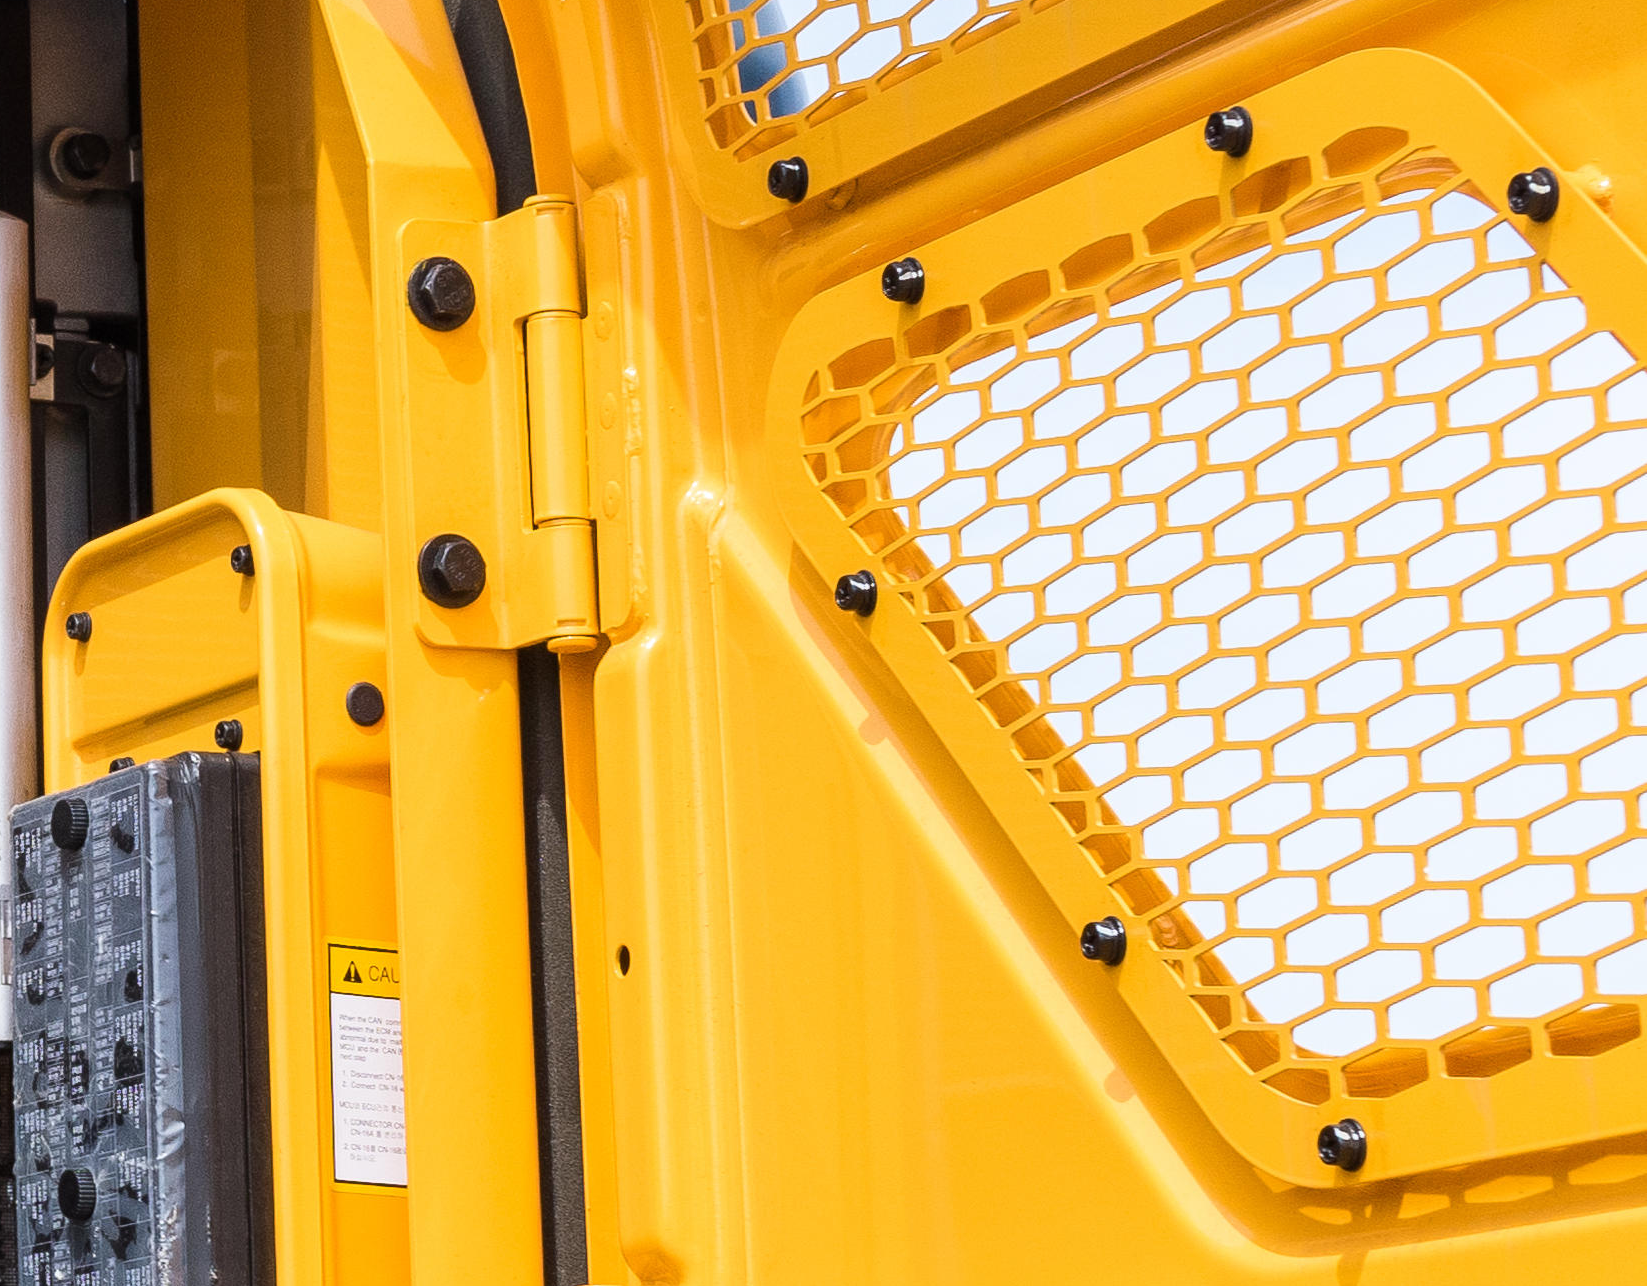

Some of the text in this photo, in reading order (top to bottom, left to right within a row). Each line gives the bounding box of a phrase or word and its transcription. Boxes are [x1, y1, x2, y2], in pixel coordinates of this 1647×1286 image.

[368, 1017, 383, 1025] CAN
[382, 1047, 397, 1055] CAN
[350, 1070, 384, 1080] Disconnect
[350, 1081, 376, 1090] Connect
[350, 1118, 393, 1129] CONNECTOR
